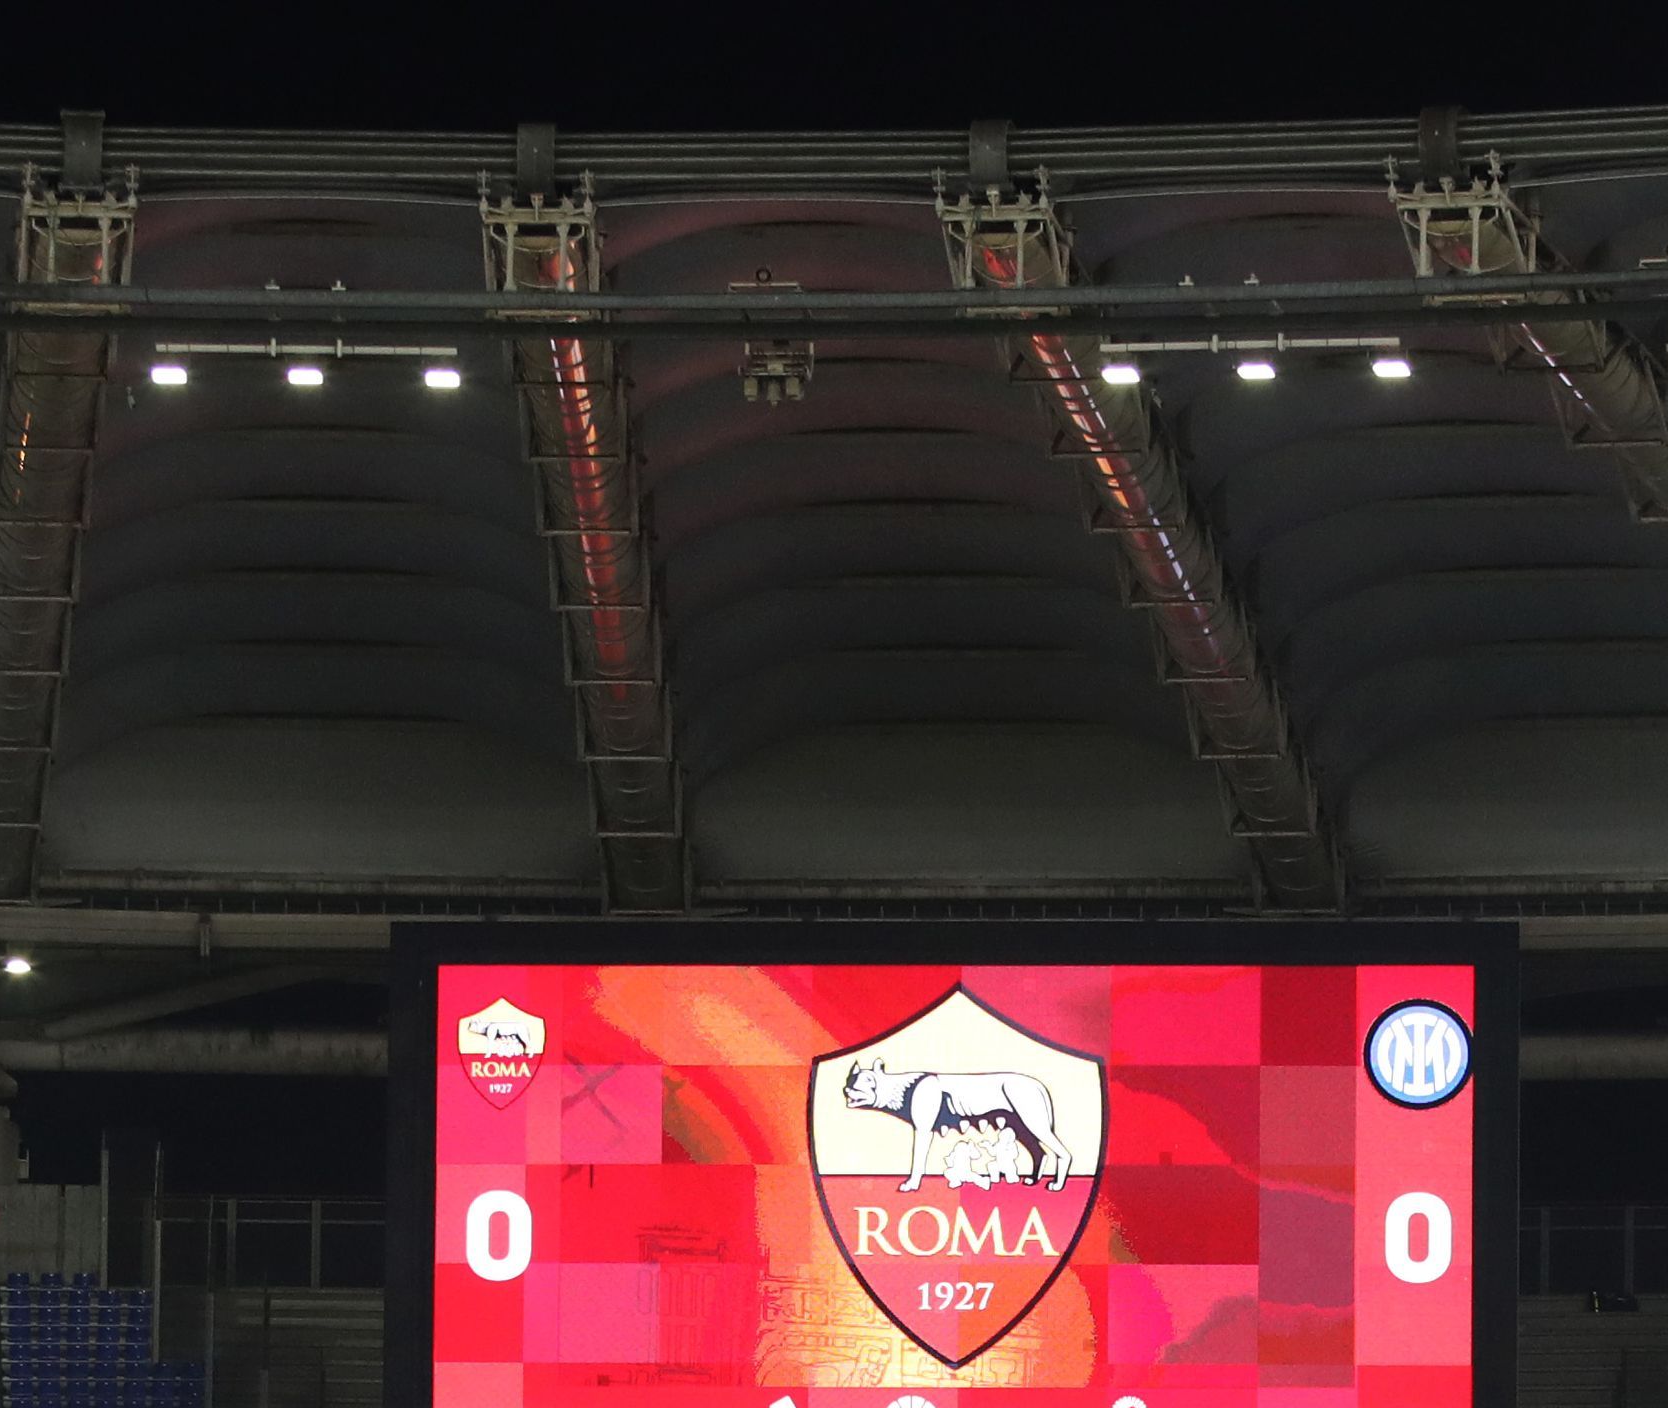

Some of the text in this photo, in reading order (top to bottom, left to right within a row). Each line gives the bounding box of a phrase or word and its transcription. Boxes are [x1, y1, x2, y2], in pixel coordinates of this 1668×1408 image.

[471, 1061, 531, 1077] ROMA
[489, 1083, 513, 1093] 1927
[464, 1190, 532, 1281] 0
[853, 1205, 1061, 1258] ROMA
[1384, 1192, 1453, 1283] 0
[916, 1280, 994, 1312] 1927
